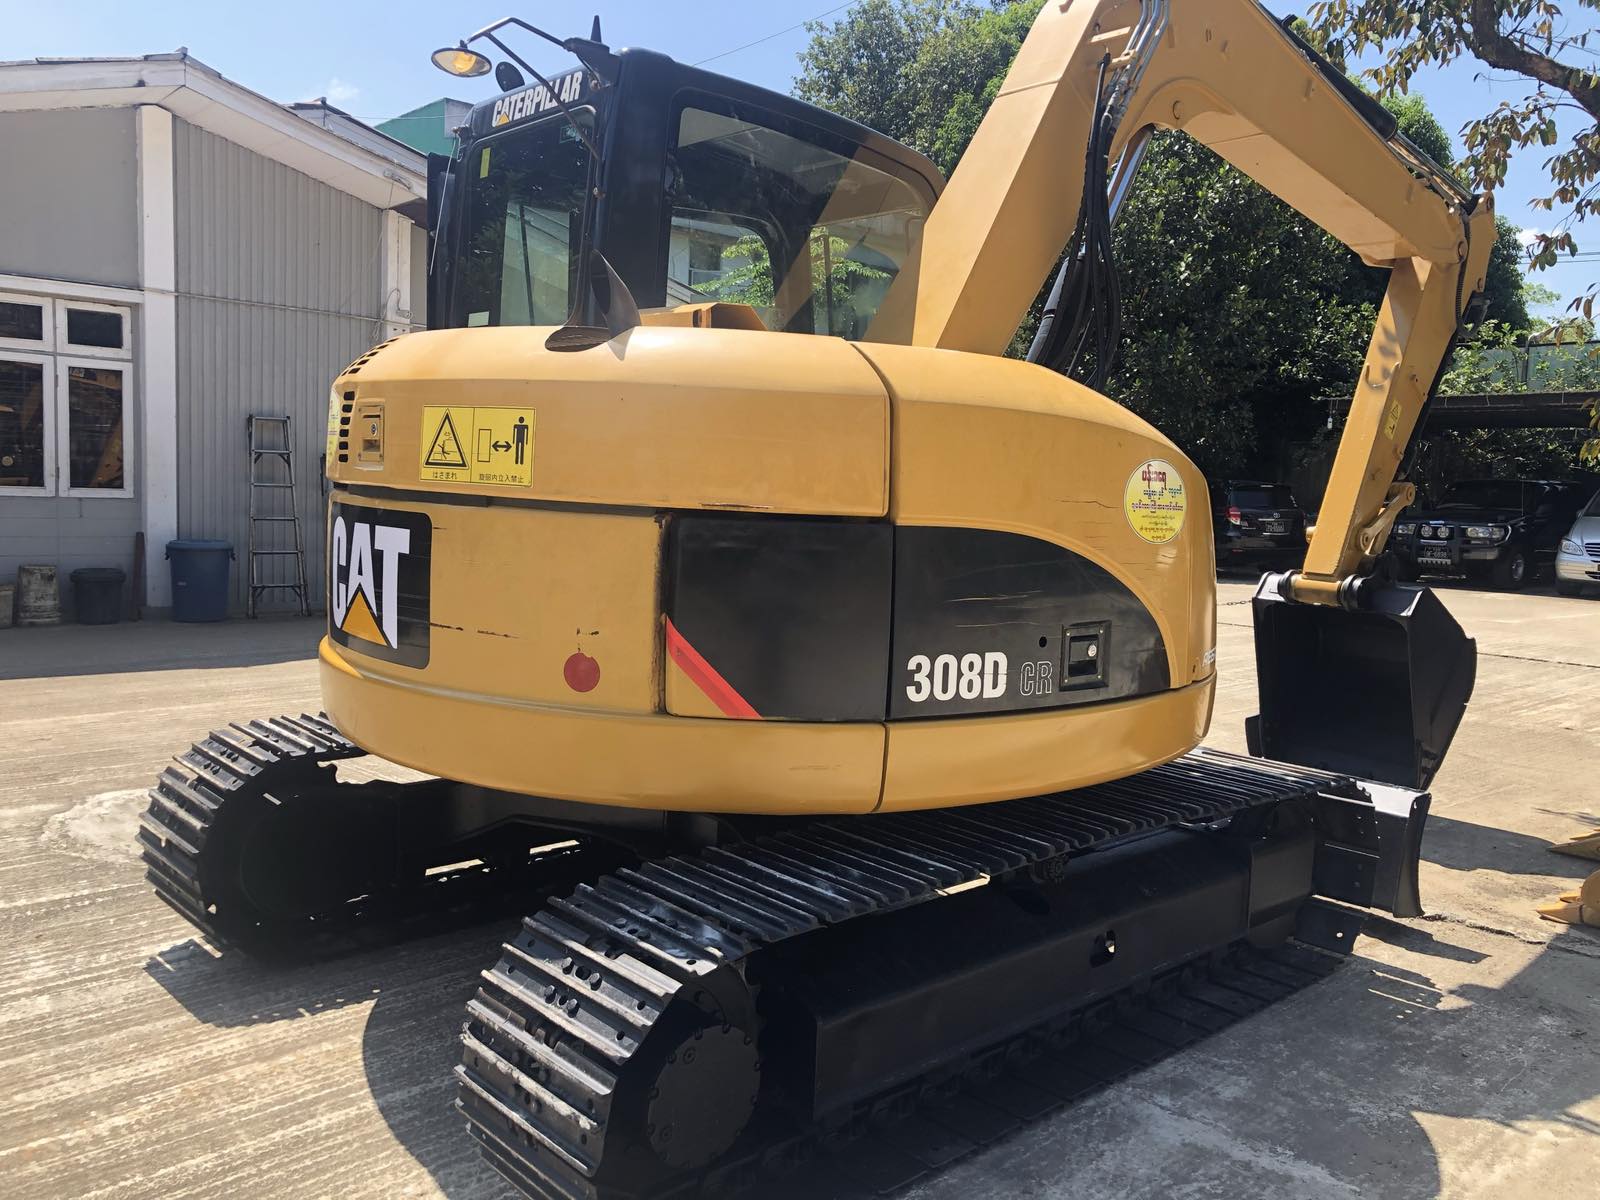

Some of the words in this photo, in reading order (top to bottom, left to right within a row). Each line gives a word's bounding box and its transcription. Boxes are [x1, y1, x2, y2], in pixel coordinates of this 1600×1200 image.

[491, 71, 583, 128] CATERPILLAR
[332, 515, 411, 650] CAT
[905, 651, 1009, 703] 308D
[1019, 660, 1052, 697] CR
